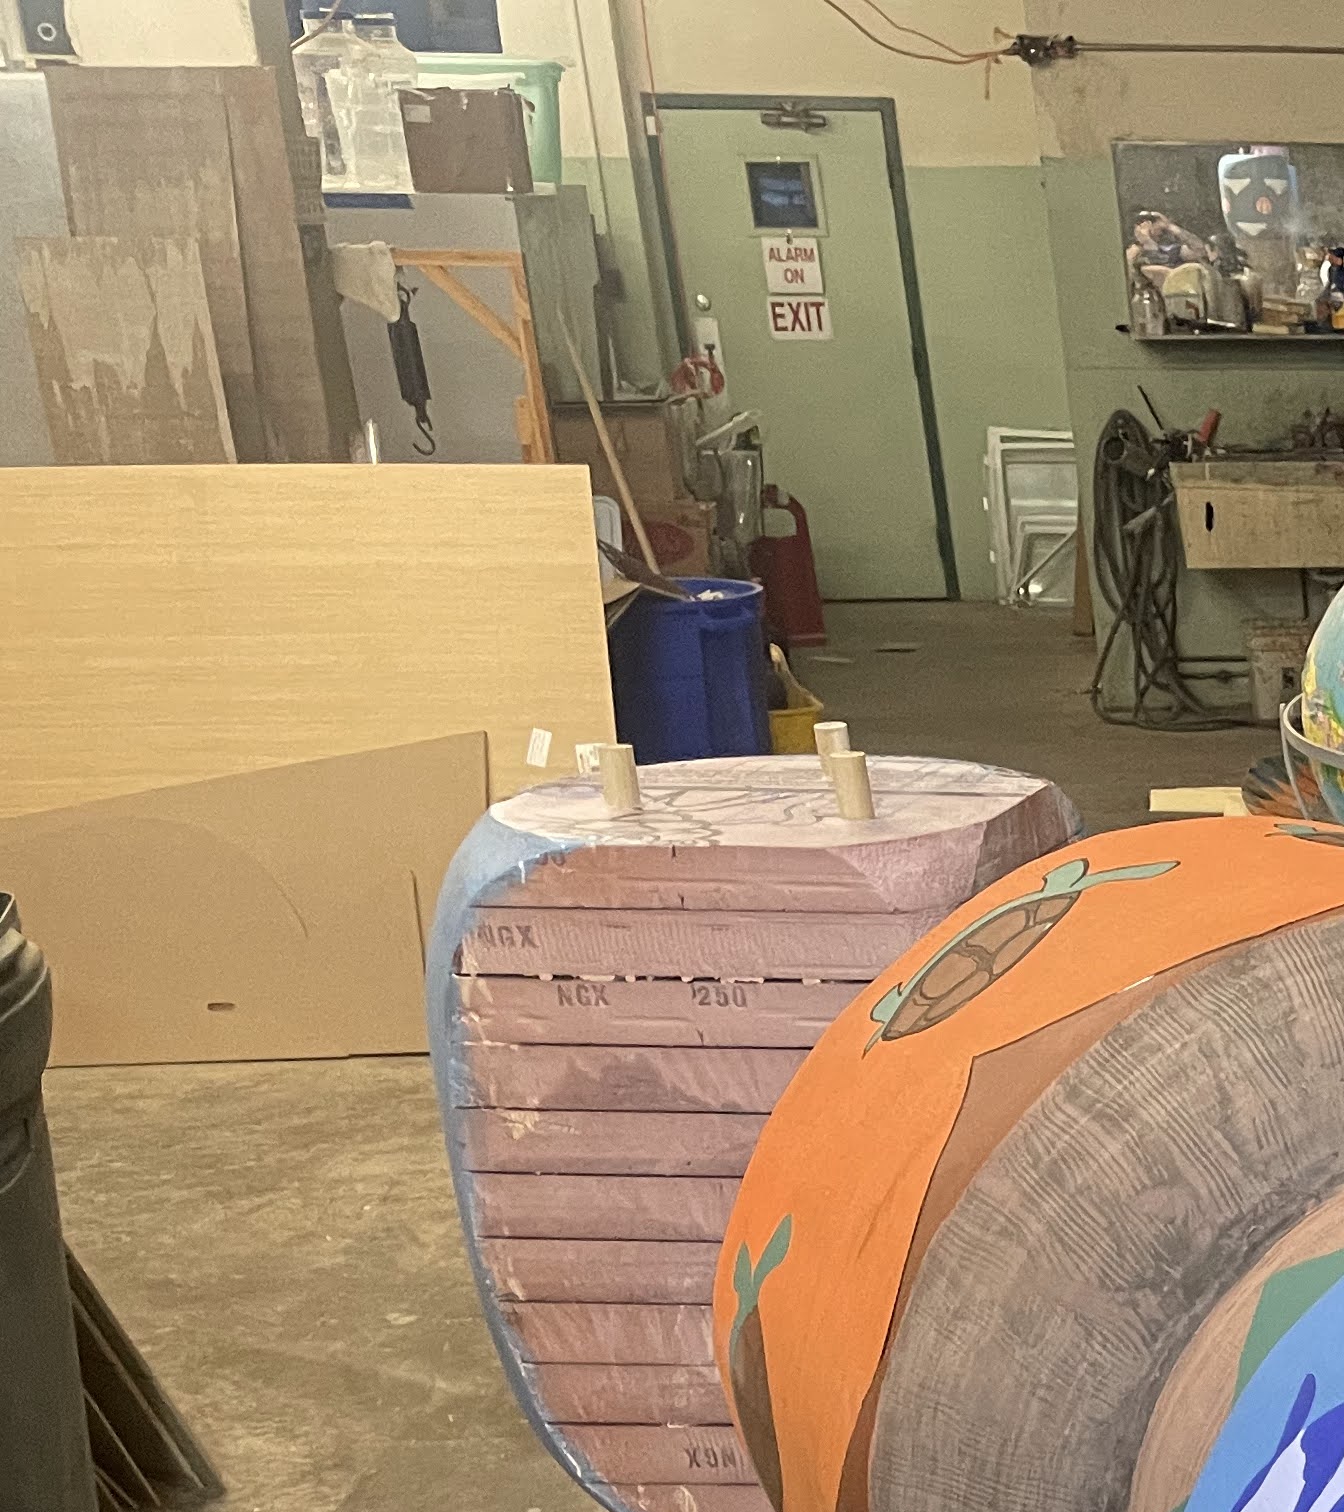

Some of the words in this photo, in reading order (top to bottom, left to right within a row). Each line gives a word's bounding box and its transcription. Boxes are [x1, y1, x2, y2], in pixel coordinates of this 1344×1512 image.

[768, 247, 816, 262] ALARM
[783, 267, 805, 284] ON
[770, 301, 825, 331] EXIT
[556, 983, 612, 1008] NGX
[698, 983, 748, 1009] 250
